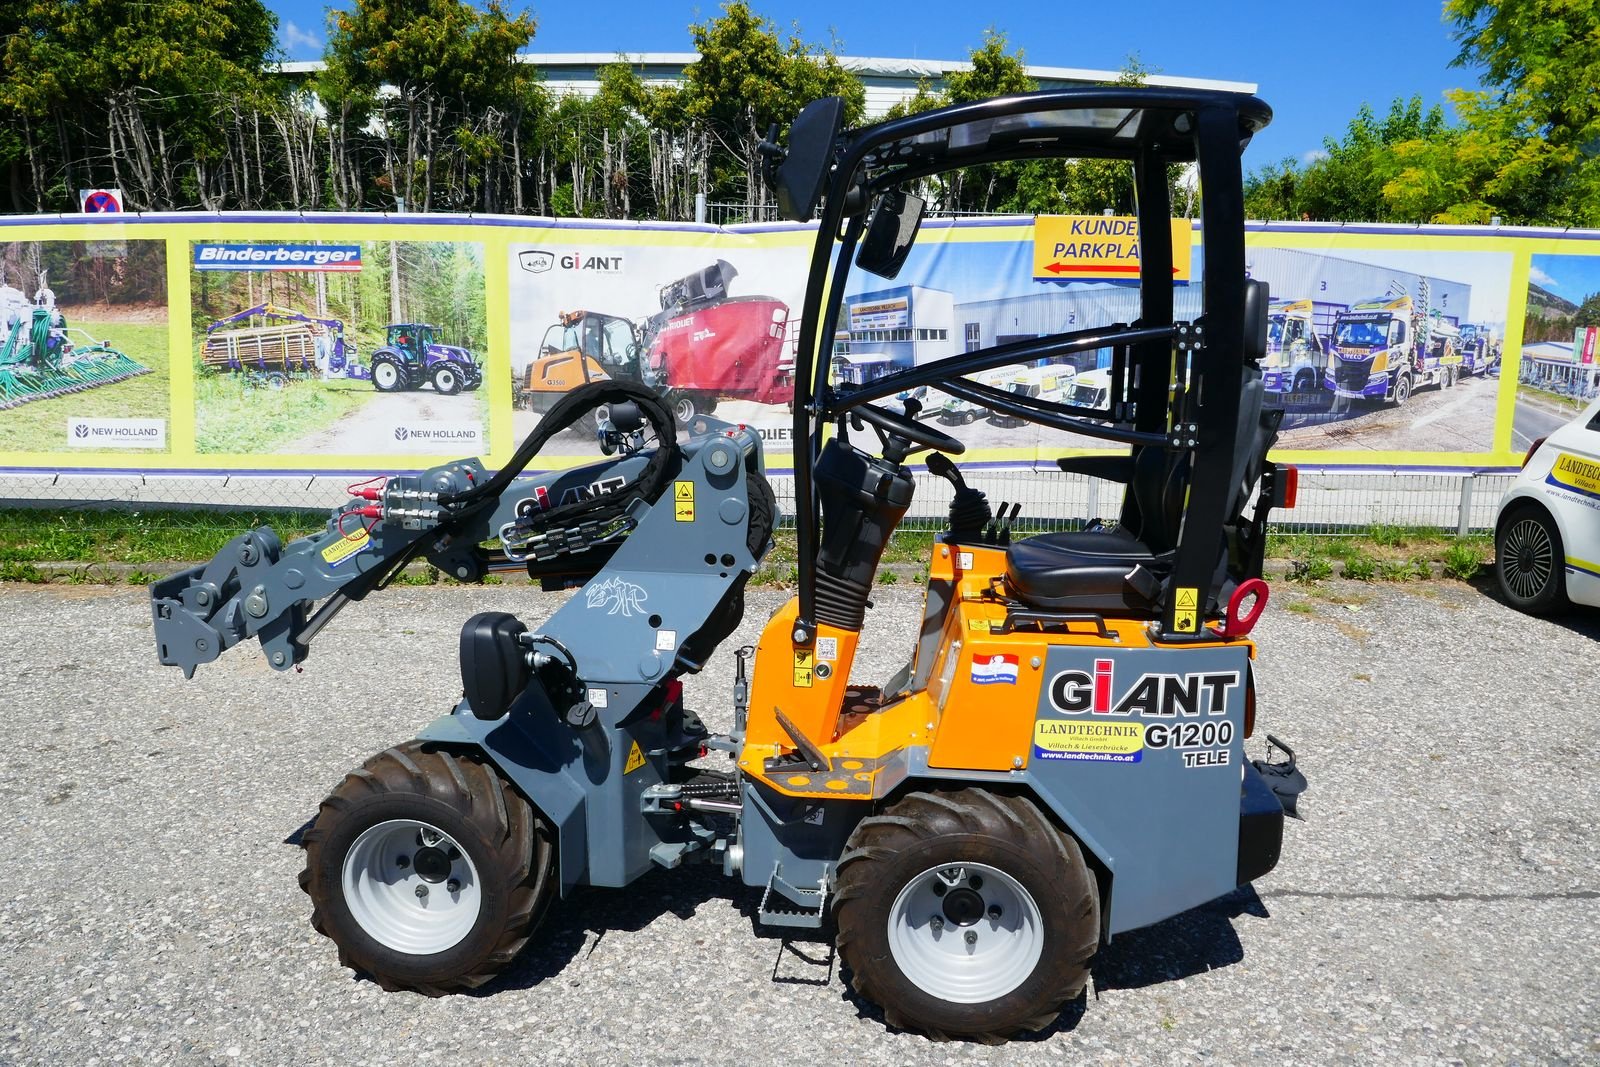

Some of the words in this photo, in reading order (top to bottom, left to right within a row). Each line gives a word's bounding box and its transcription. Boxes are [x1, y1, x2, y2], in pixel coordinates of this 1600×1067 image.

[1071, 219, 1138, 236] KUNDE
[1053, 238, 1139, 259] PARKPLÄ
[199, 247, 357, 264] Binderberger
[1320, 281, 1327, 291] 3
[1014, 317, 1018, 326] 1
[1068, 315, 1075, 324] 2
[91, 427, 113, 436] NEW
[115, 427, 158, 436] HOLLAND
[410, 430, 431, 438] NEW
[433, 430, 476, 438] HOLLAND
[758, 428, 793, 440] OLIET
[1574, 477, 1597, 490] Villach
[1040, 723, 1139, 737] LANDTECHNIK
[1144, 720, 1234, 750] G1200
[1081, 743, 1129, 751] Lieserbrücke
[1041, 751, 1135, 762] www.landtechnik.co.at
[1182, 748, 1231, 769] TELE
